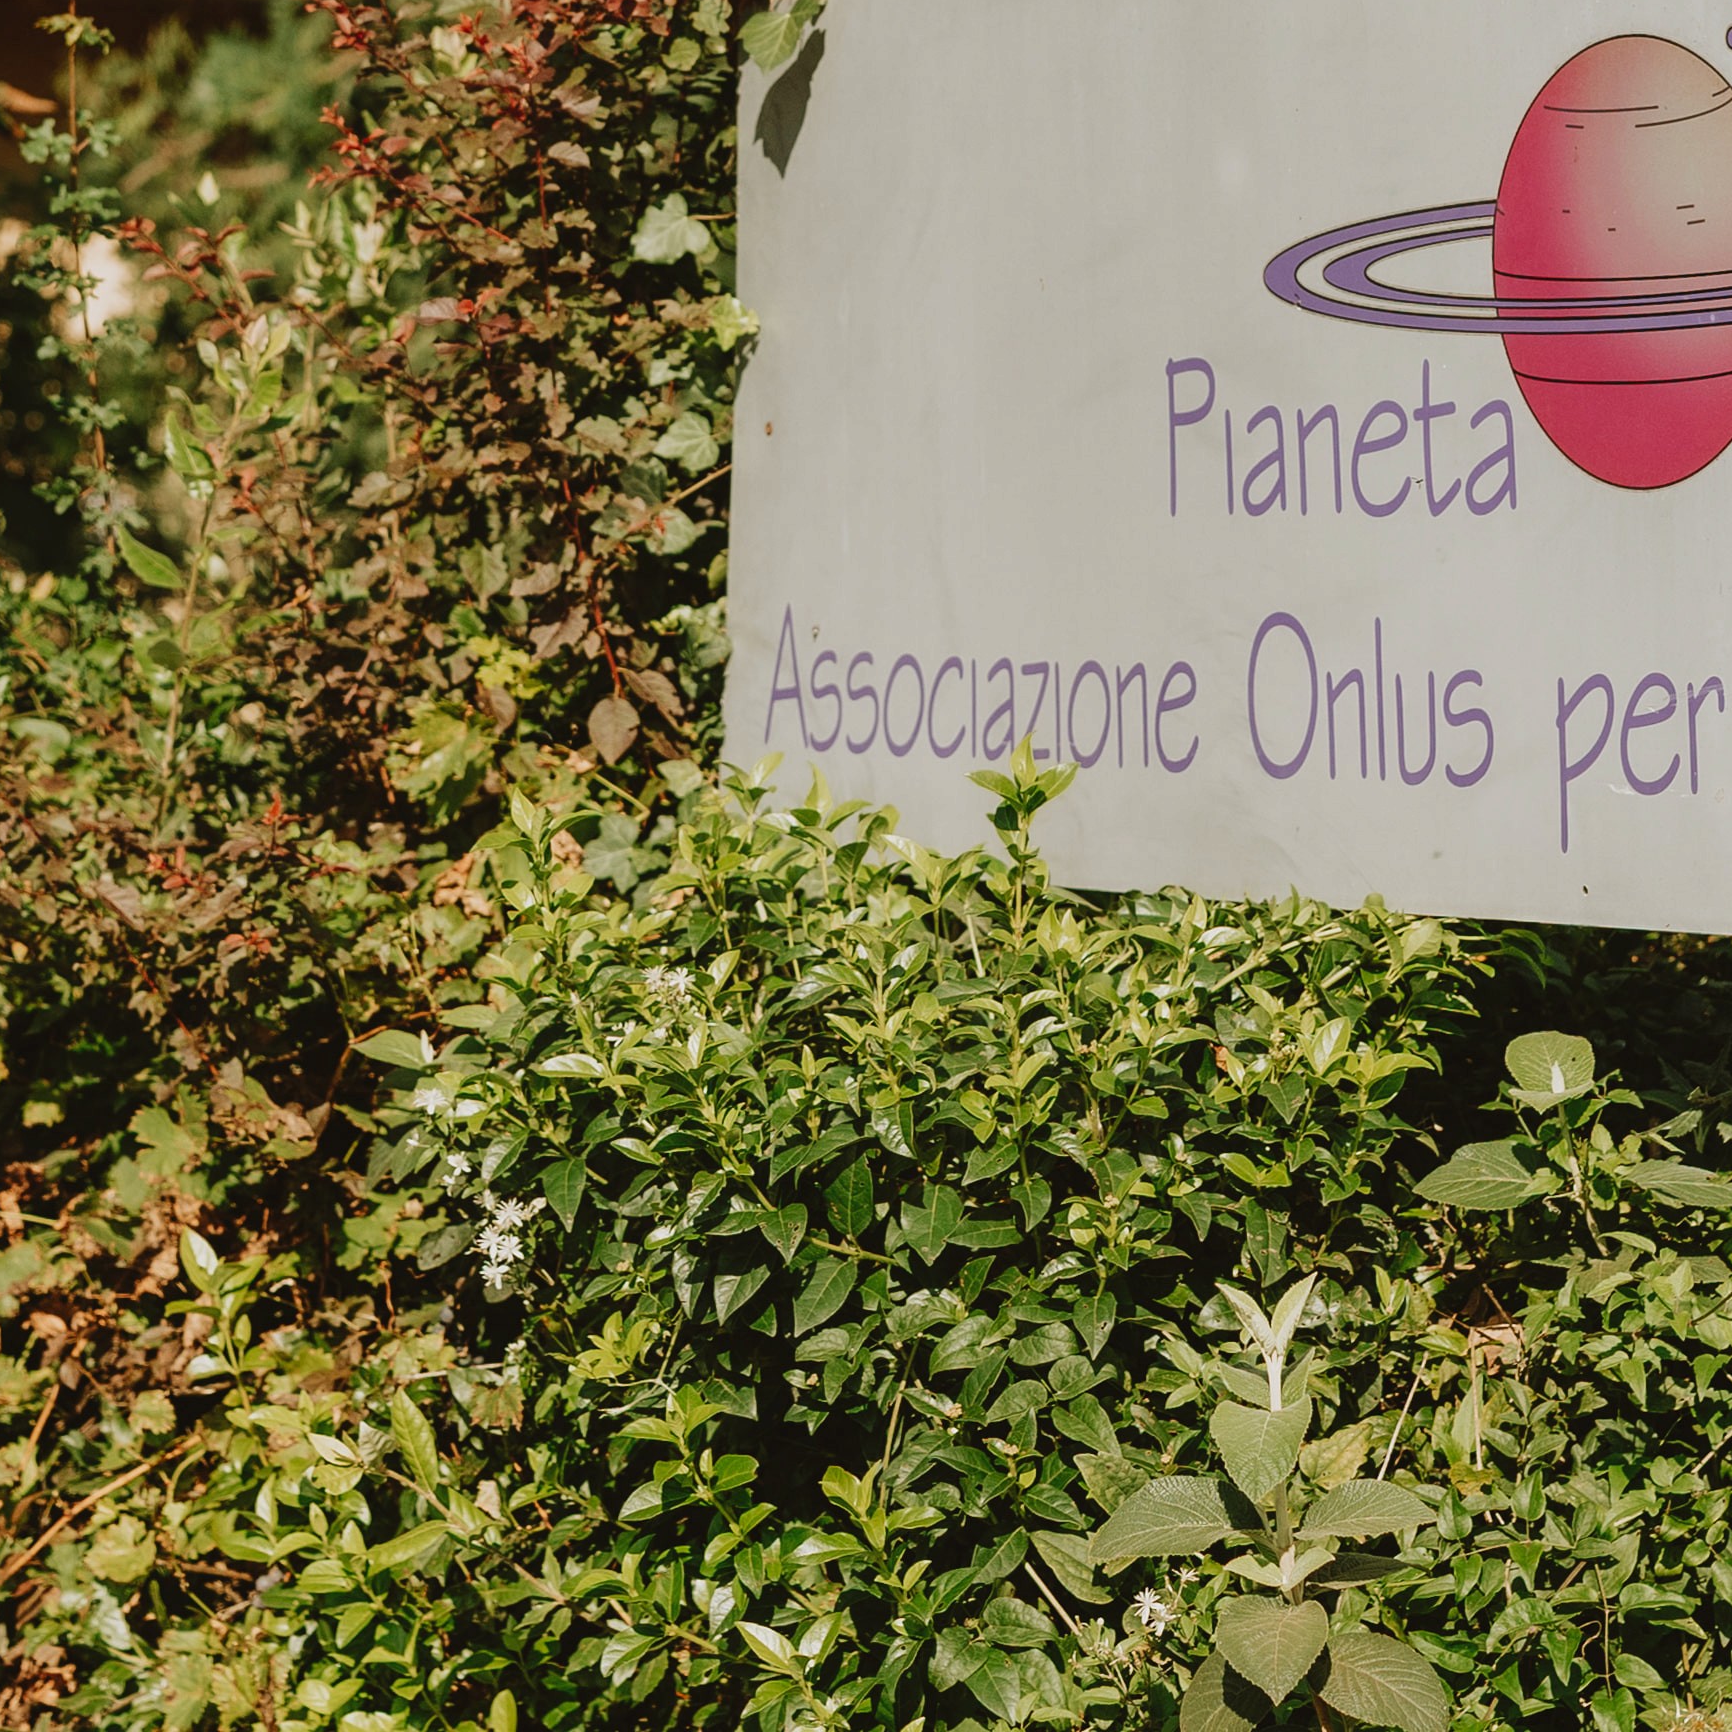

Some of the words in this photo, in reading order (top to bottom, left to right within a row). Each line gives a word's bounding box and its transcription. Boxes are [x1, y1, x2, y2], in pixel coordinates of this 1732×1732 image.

[1168, 357, 1517, 518] Pianeta
[764, 604, 1199, 774] Associazione
[1248, 611, 1496, 787] Onlus
[1556, 671, 1724, 853] per
